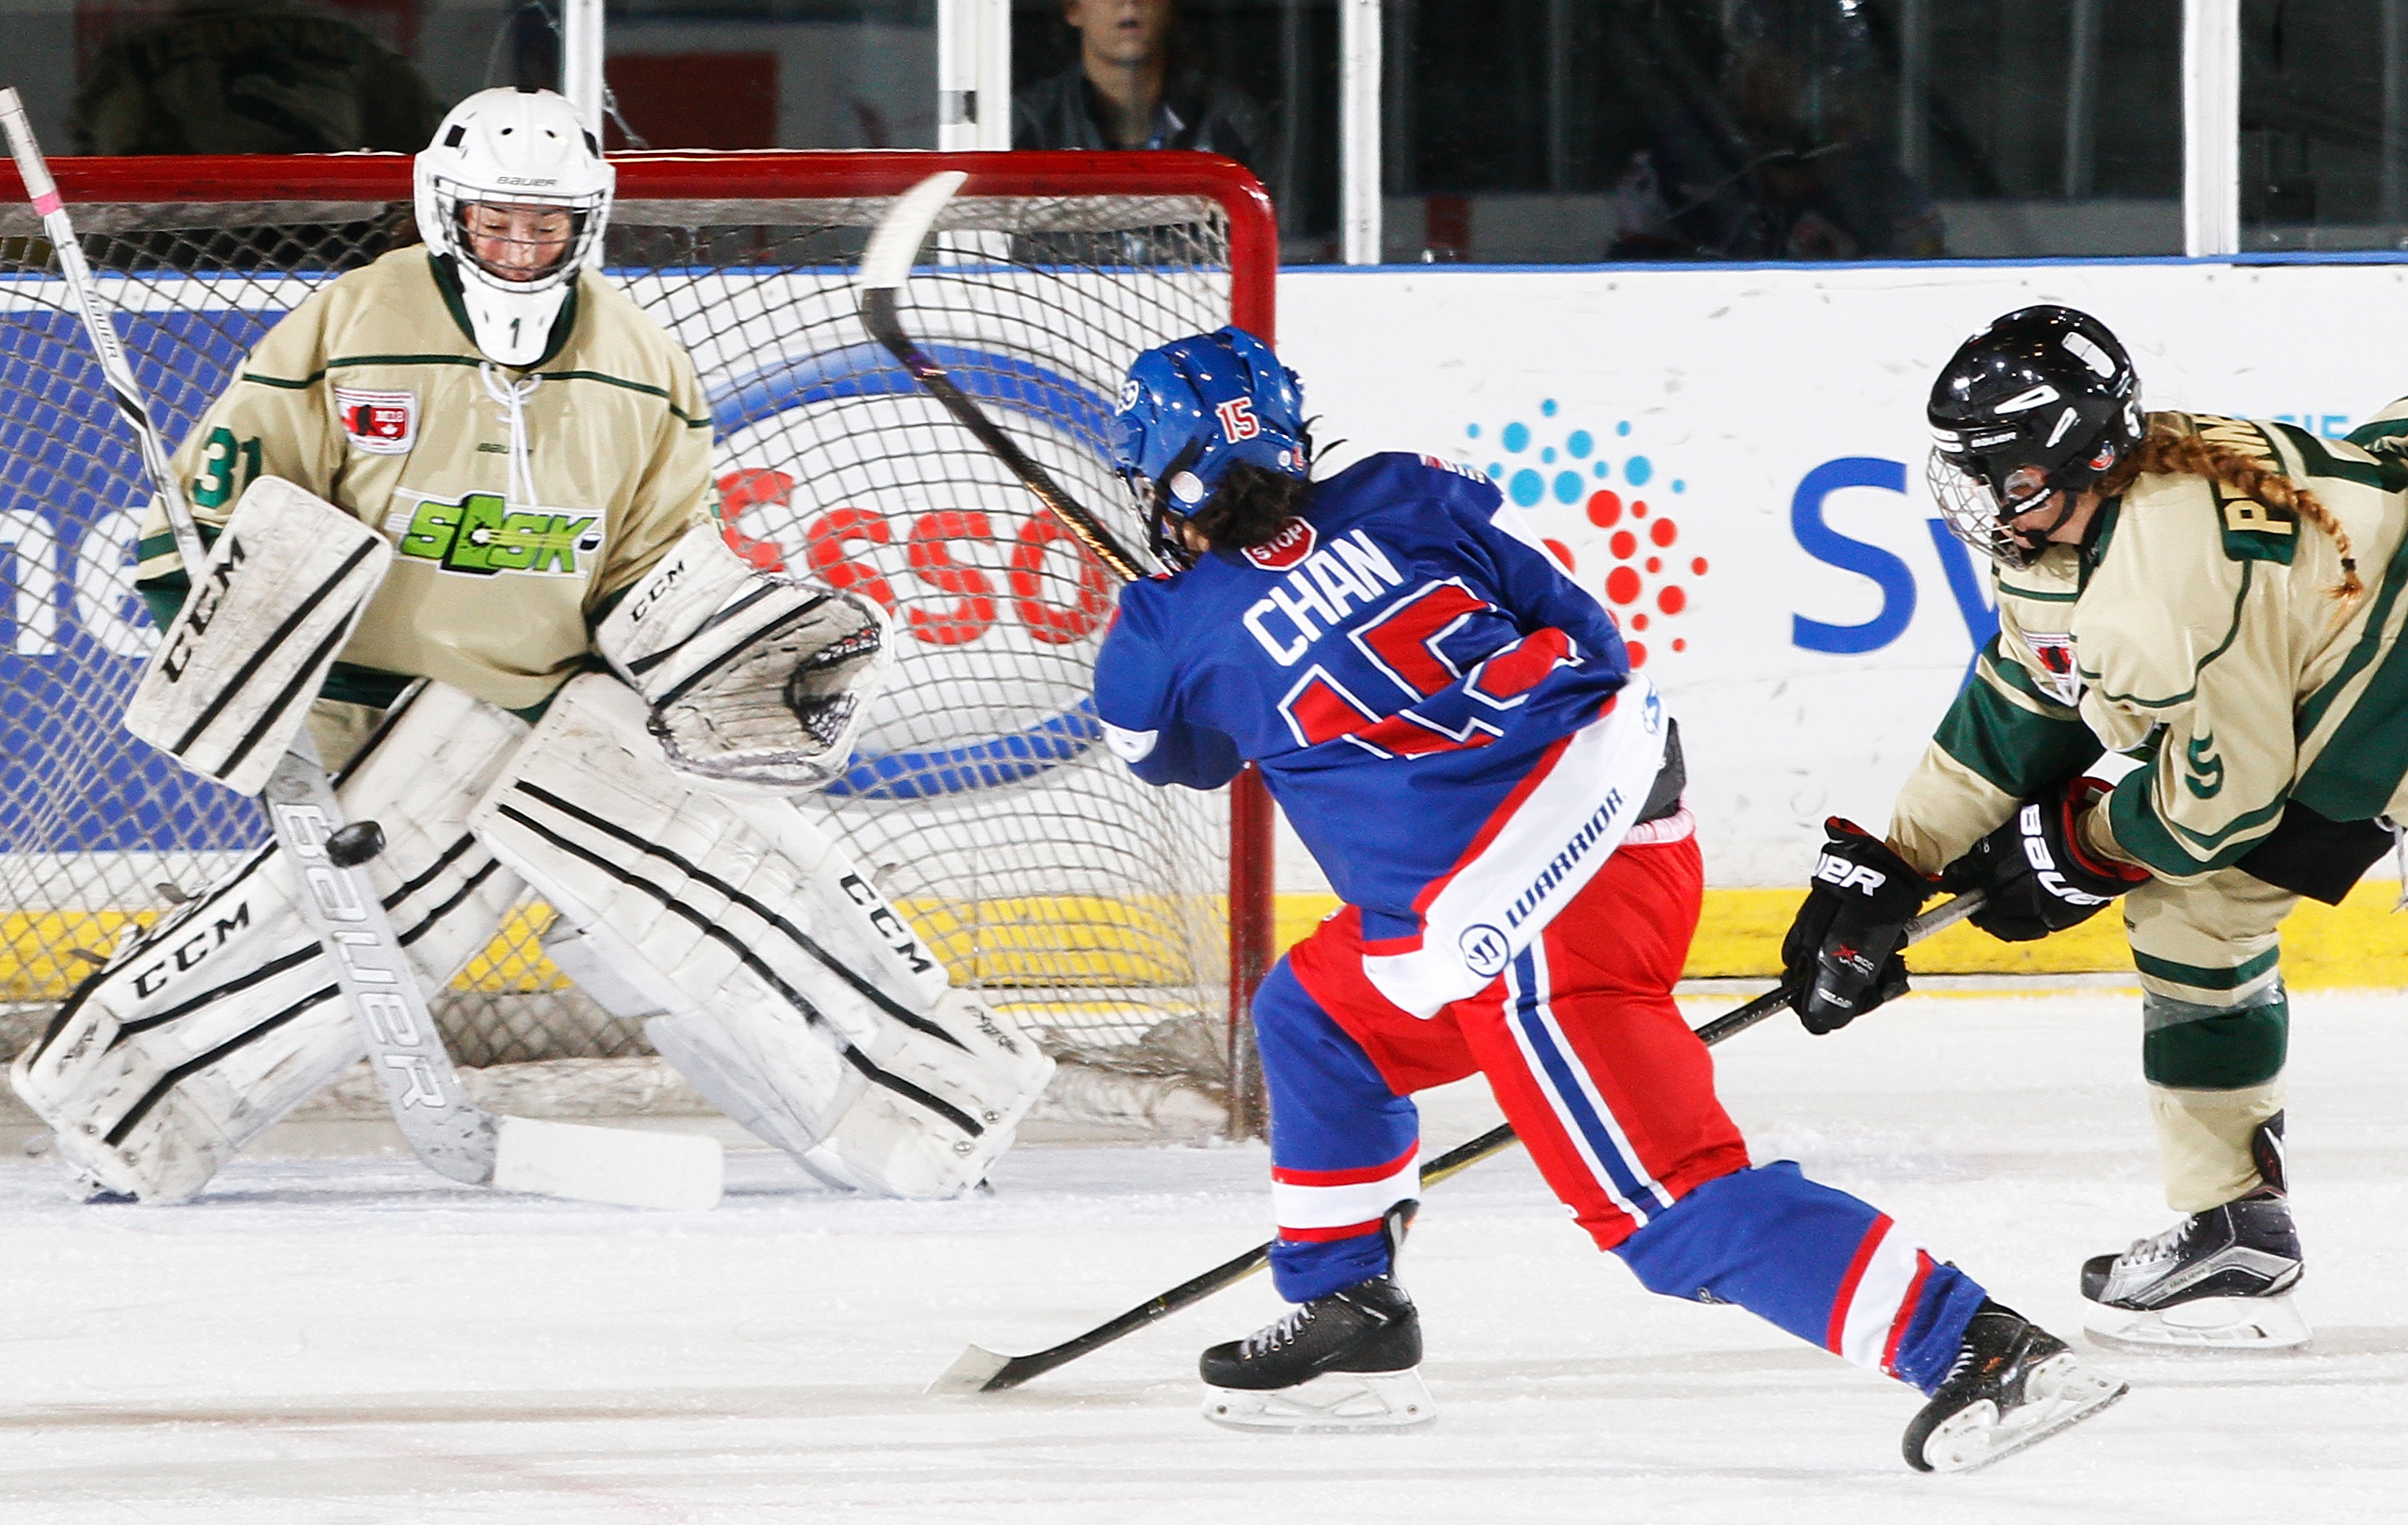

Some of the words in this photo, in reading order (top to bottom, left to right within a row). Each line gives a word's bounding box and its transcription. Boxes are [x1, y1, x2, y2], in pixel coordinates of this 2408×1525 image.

[496, 176, 558, 186] BAUER
[84, 289, 119, 359] BAUER
[509, 317, 521, 350] 1
[1214, 396, 1261, 444] 15
[193, 426, 263, 509] 31
[1251, 523, 1303, 560] STOP
[160, 535, 246, 684] CCM
[629, 560, 687, 623] CCM
[1243, 528, 1404, 667] CHAN
[1277, 575, 1585, 762] 15
[1504, 787, 1626, 930] WARRIOR
[133, 901, 250, 999] CCM
[275, 803, 447, 1110] BAUER
[839, 873, 934, 974] CCM
